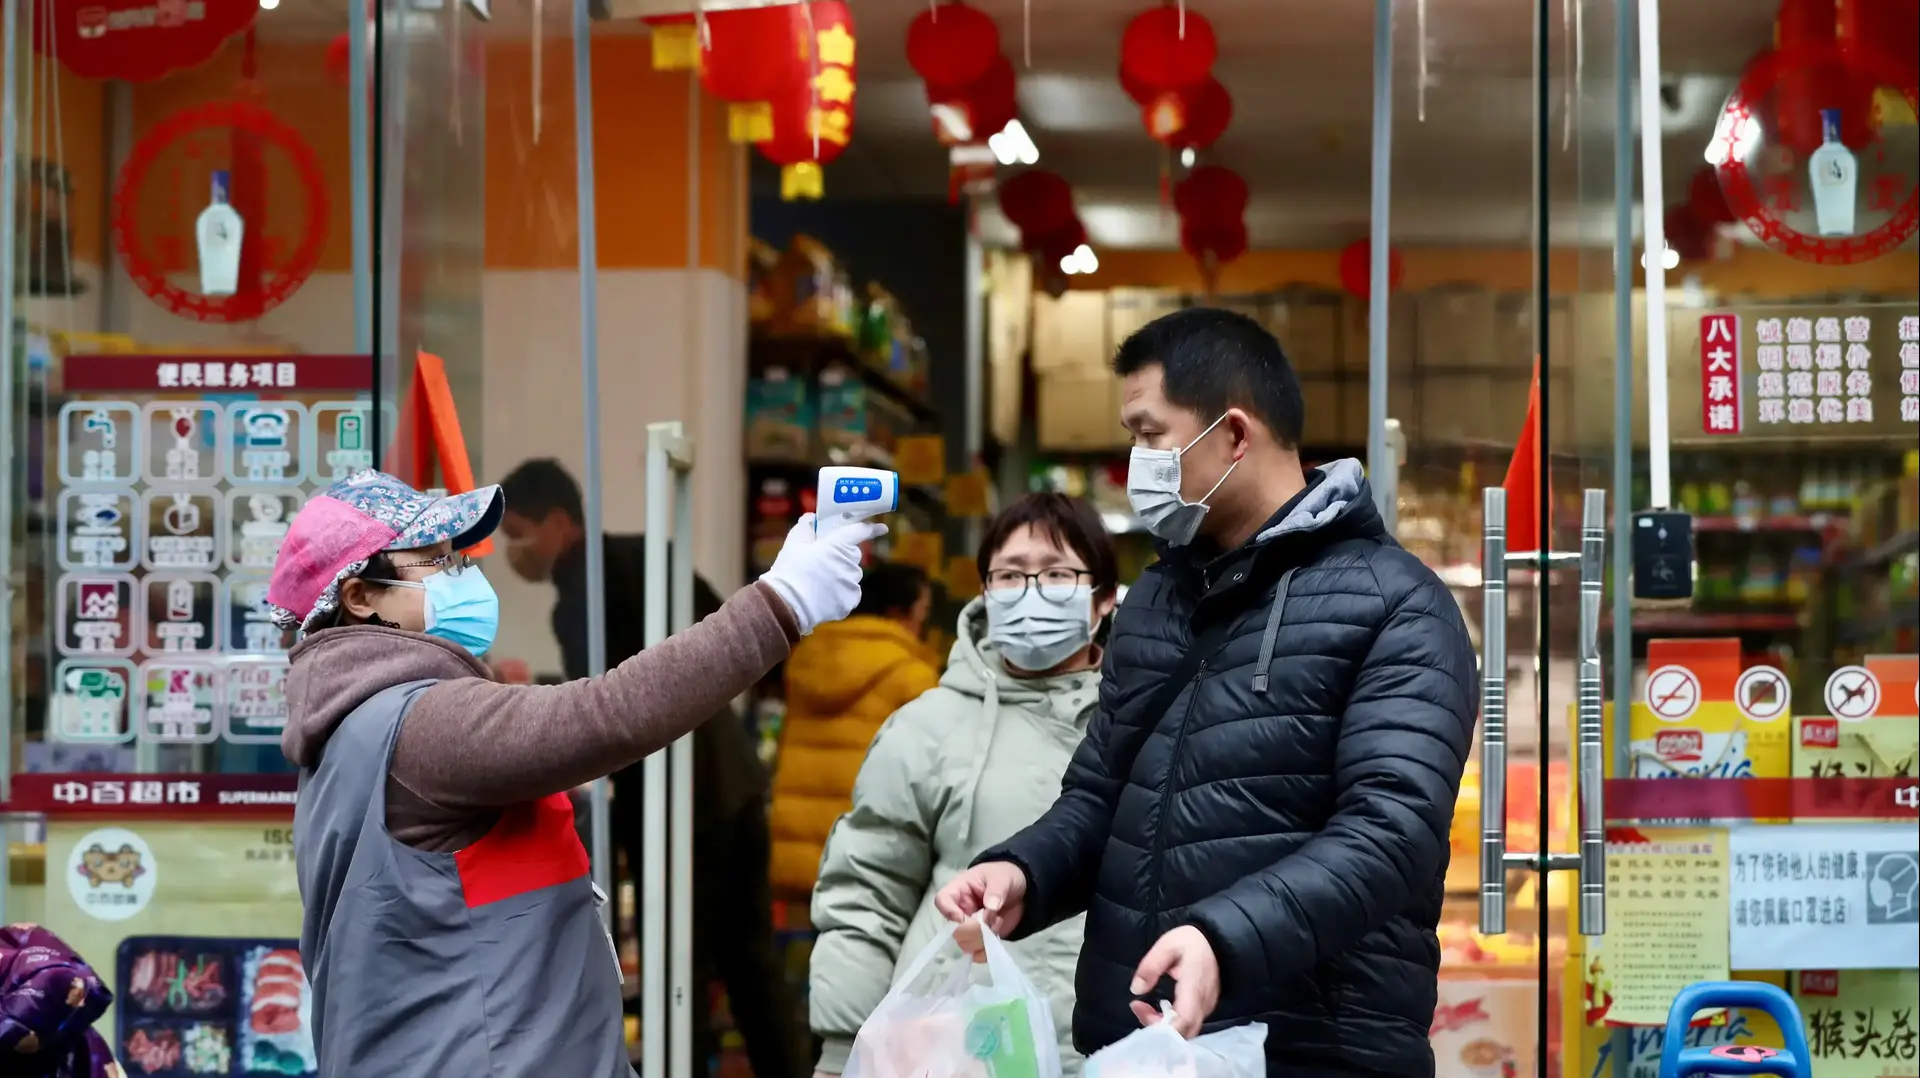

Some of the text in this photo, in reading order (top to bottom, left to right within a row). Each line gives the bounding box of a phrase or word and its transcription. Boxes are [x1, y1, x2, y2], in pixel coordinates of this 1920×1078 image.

[157, 362, 296, 387] 便民服务项目
[1706, 318, 1734, 430] 八大承诺
[53, 781, 200, 804] 中百超市
[1807, 1005, 1918, 1060] 猴头菇
